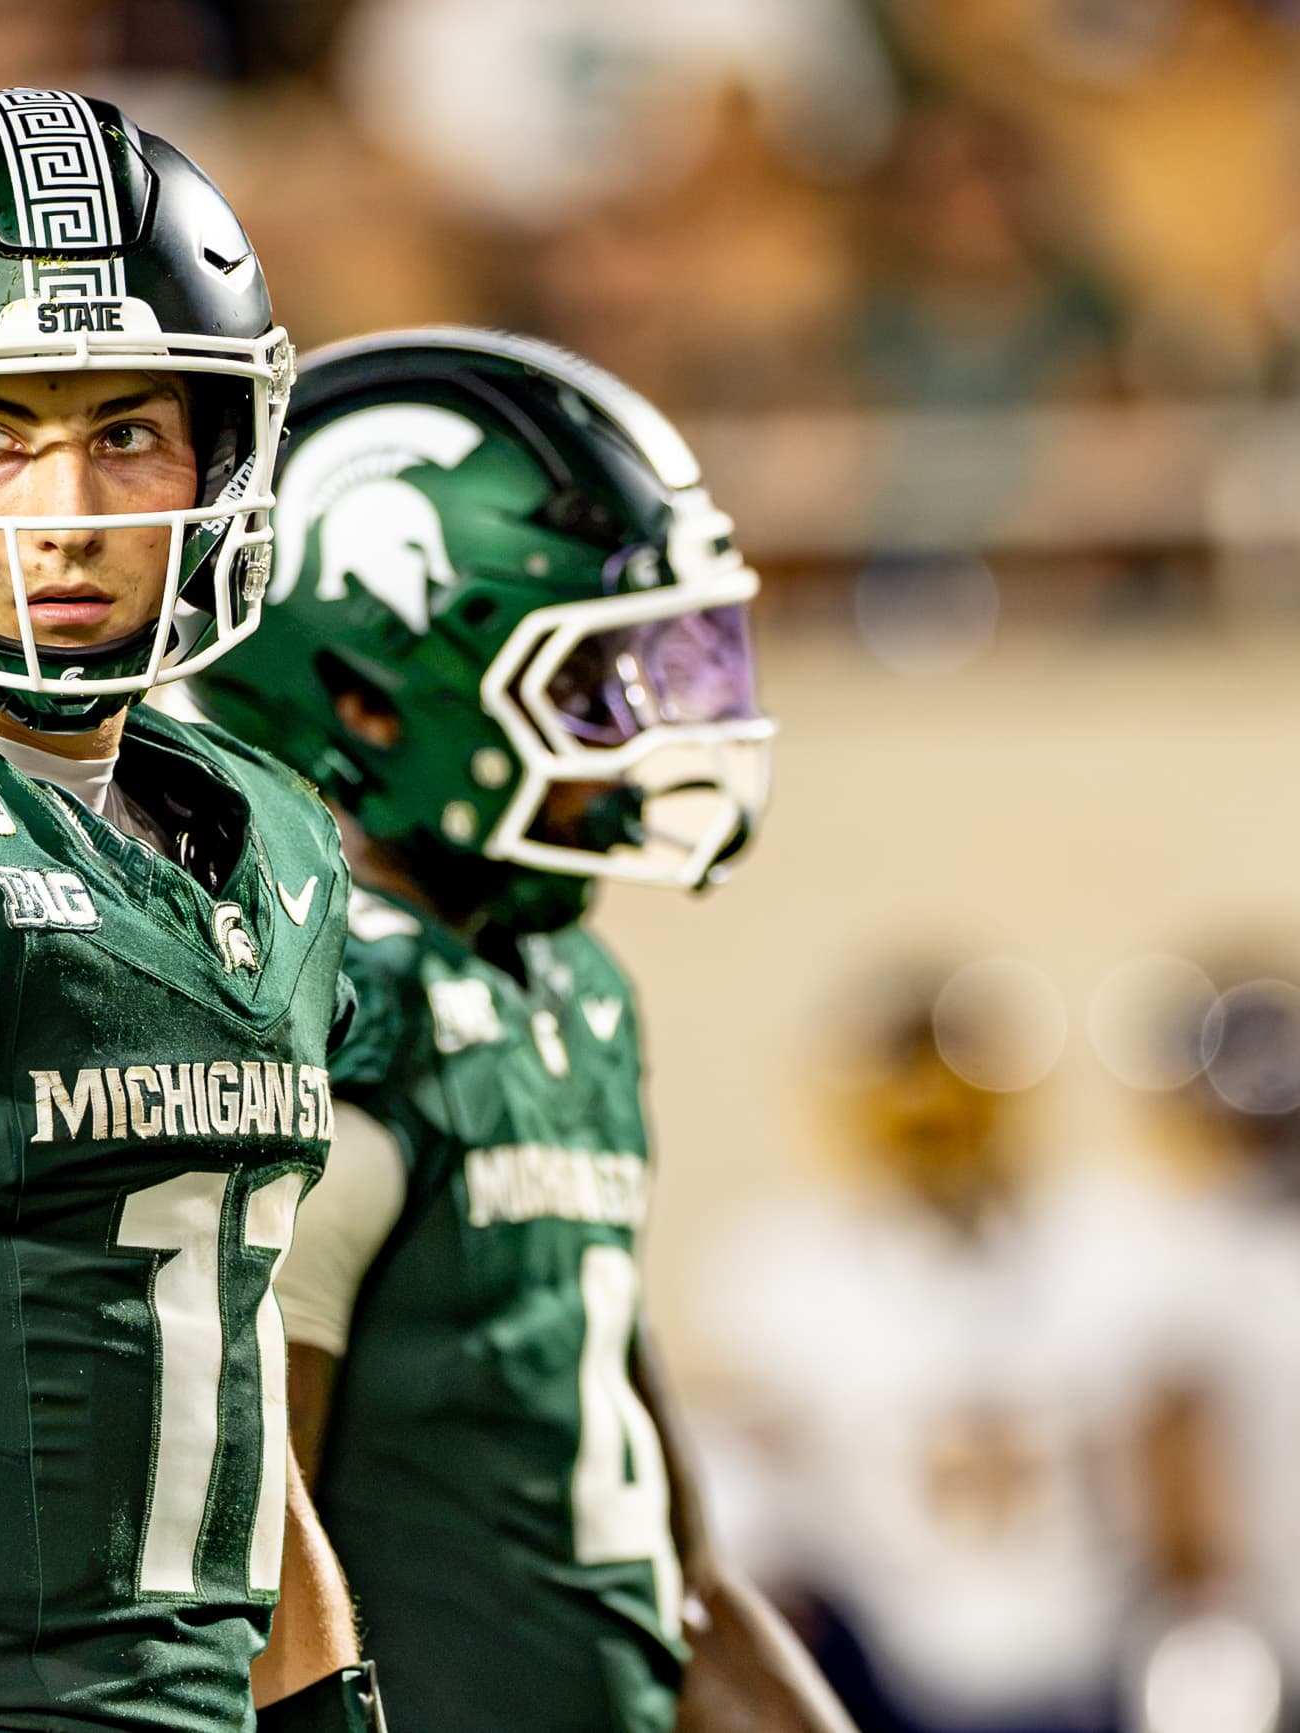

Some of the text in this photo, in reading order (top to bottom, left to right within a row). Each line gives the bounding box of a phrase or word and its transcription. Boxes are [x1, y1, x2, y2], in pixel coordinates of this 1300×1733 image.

[38, 302, 124, 333] STATE
[29, 1061, 293, 1143] MICHIGAN
[116, 1170, 310, 1593] 11
